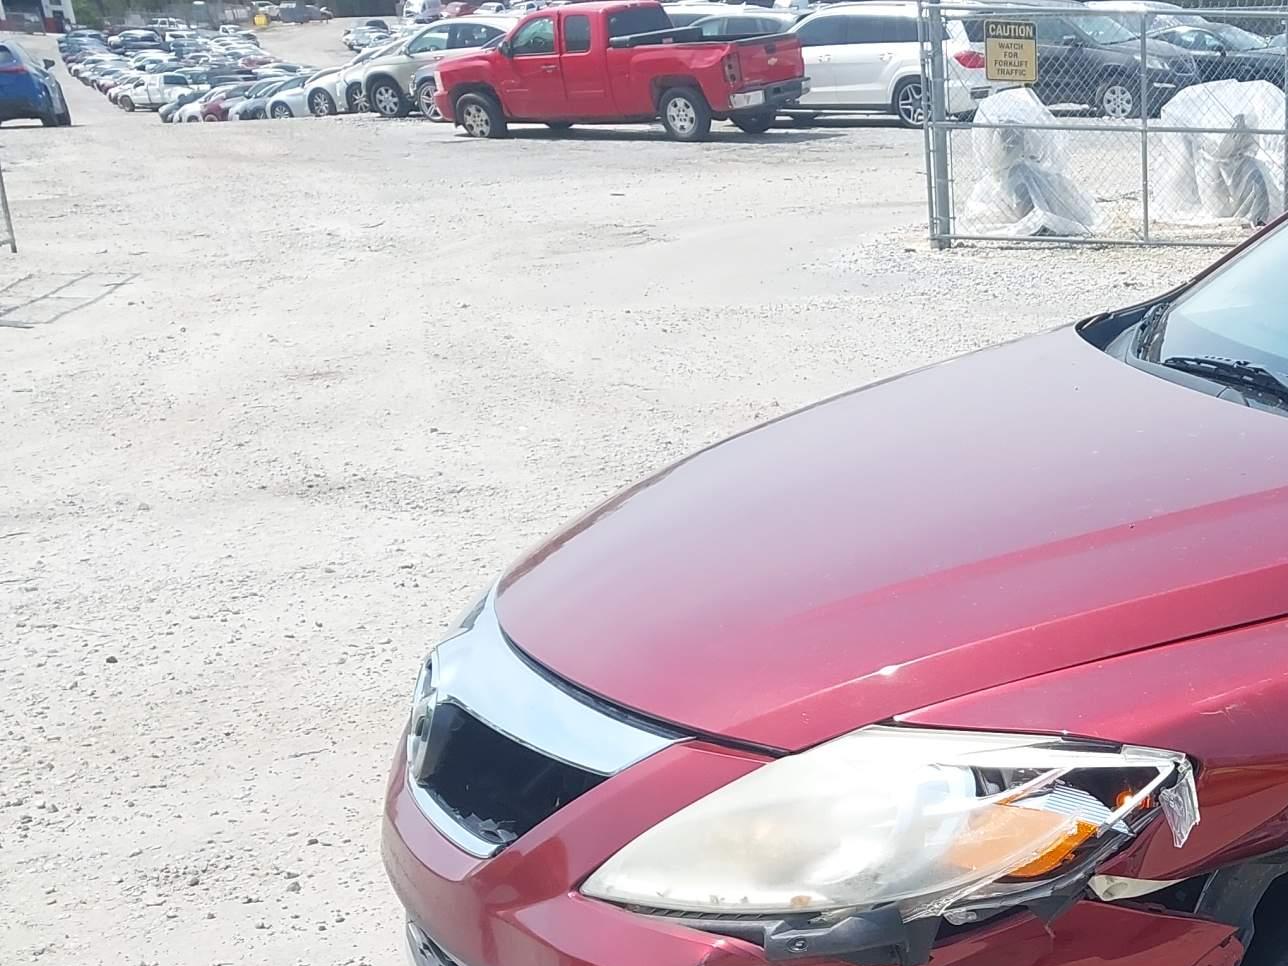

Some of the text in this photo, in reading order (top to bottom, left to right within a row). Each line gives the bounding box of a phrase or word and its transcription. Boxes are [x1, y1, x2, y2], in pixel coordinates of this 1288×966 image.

[989, 24, 1033, 37] CAUTION
[998, 42, 1024, 50] WATCH
[994, 59, 1028, 68] FORKLIFT
[997, 68, 1027, 76] TRAFFIC
